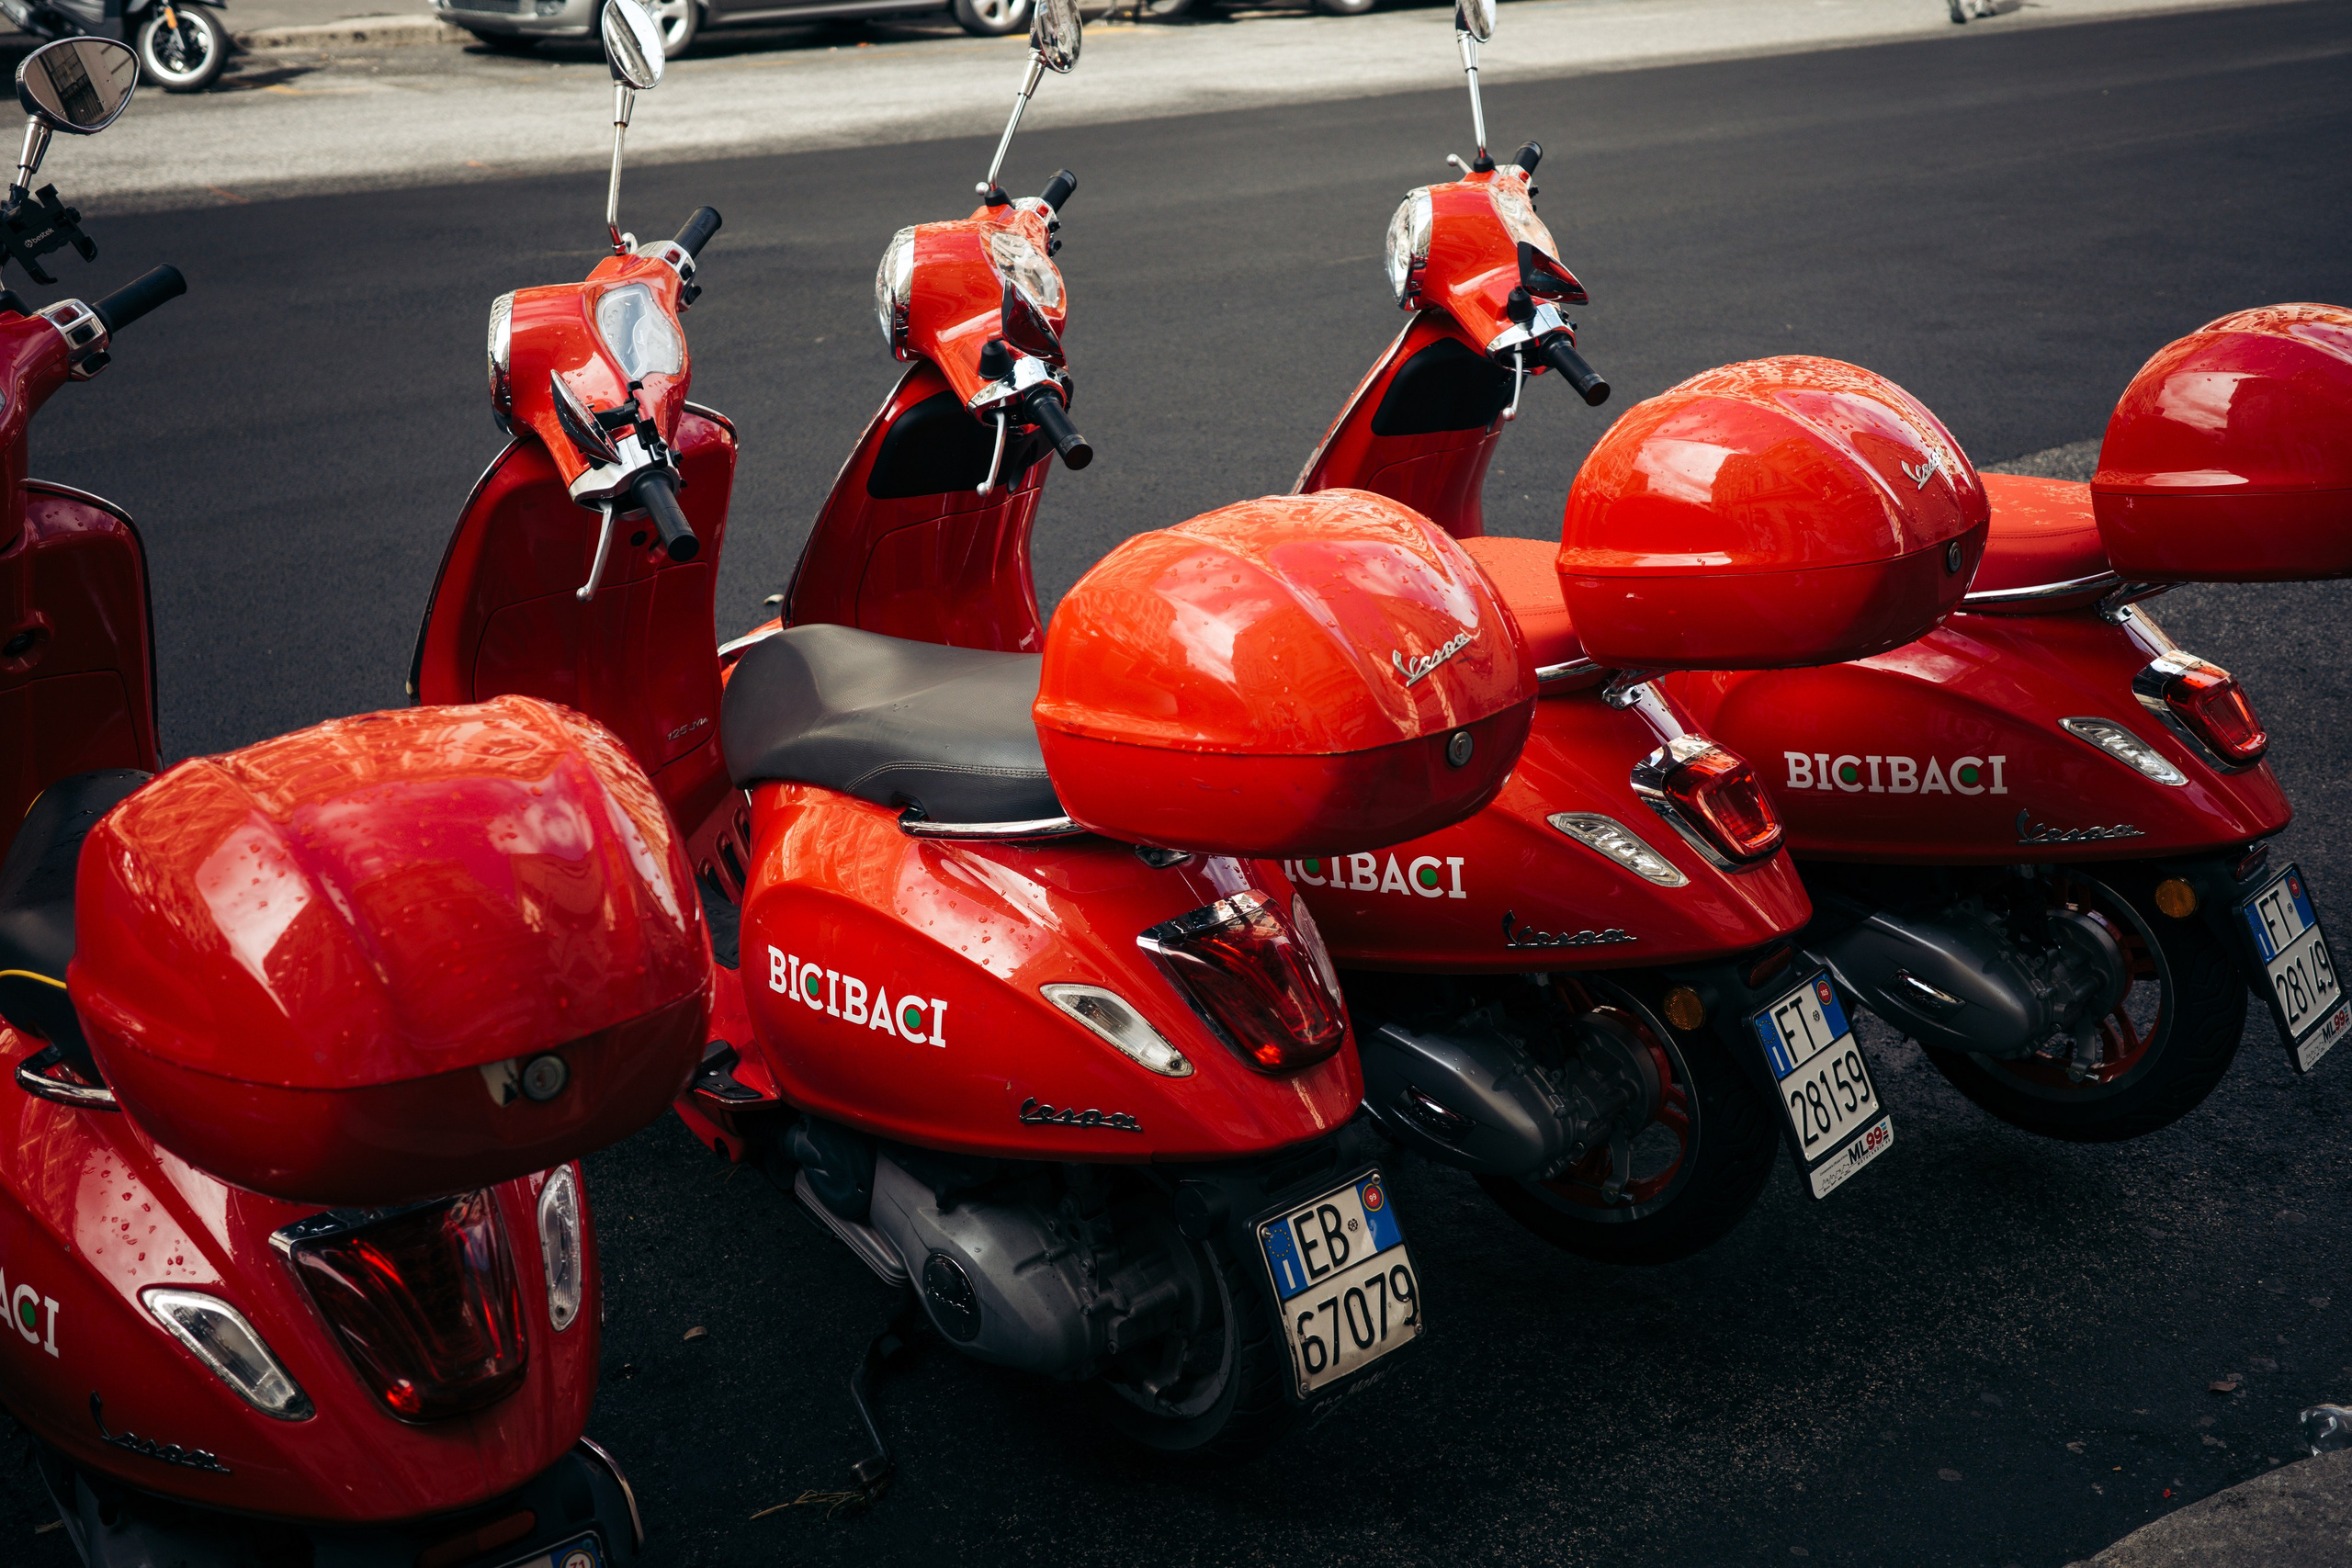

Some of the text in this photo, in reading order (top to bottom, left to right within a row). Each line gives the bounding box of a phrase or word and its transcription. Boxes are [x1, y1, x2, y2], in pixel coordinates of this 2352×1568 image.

[31, 228, 55, 243] bestek
[1392, 633, 1472, 688] Vespa
[667, 724, 688, 741] 125
[1783, 750, 2009, 795] BICIBACI
[2016, 807, 2146, 844] Vespa
[1283, 852, 1467, 899] ICIBACI
[1501, 909, 1637, 950] Vespa
[2258, 889, 2292, 950] FT
[768, 944, 947, 1048] BICIBACI
[2275, 940, 2335, 1026] 28149
[1774, 996, 1816, 1064] FT
[2322, 1010, 2346, 1043] ML99
[1790, 1050, 1871, 1148] 28159
[1848, 1126, 1883, 1165] ML99
[1293, 1203, 1350, 1280] EB
[1296, 1264, 1419, 1375] 67079
